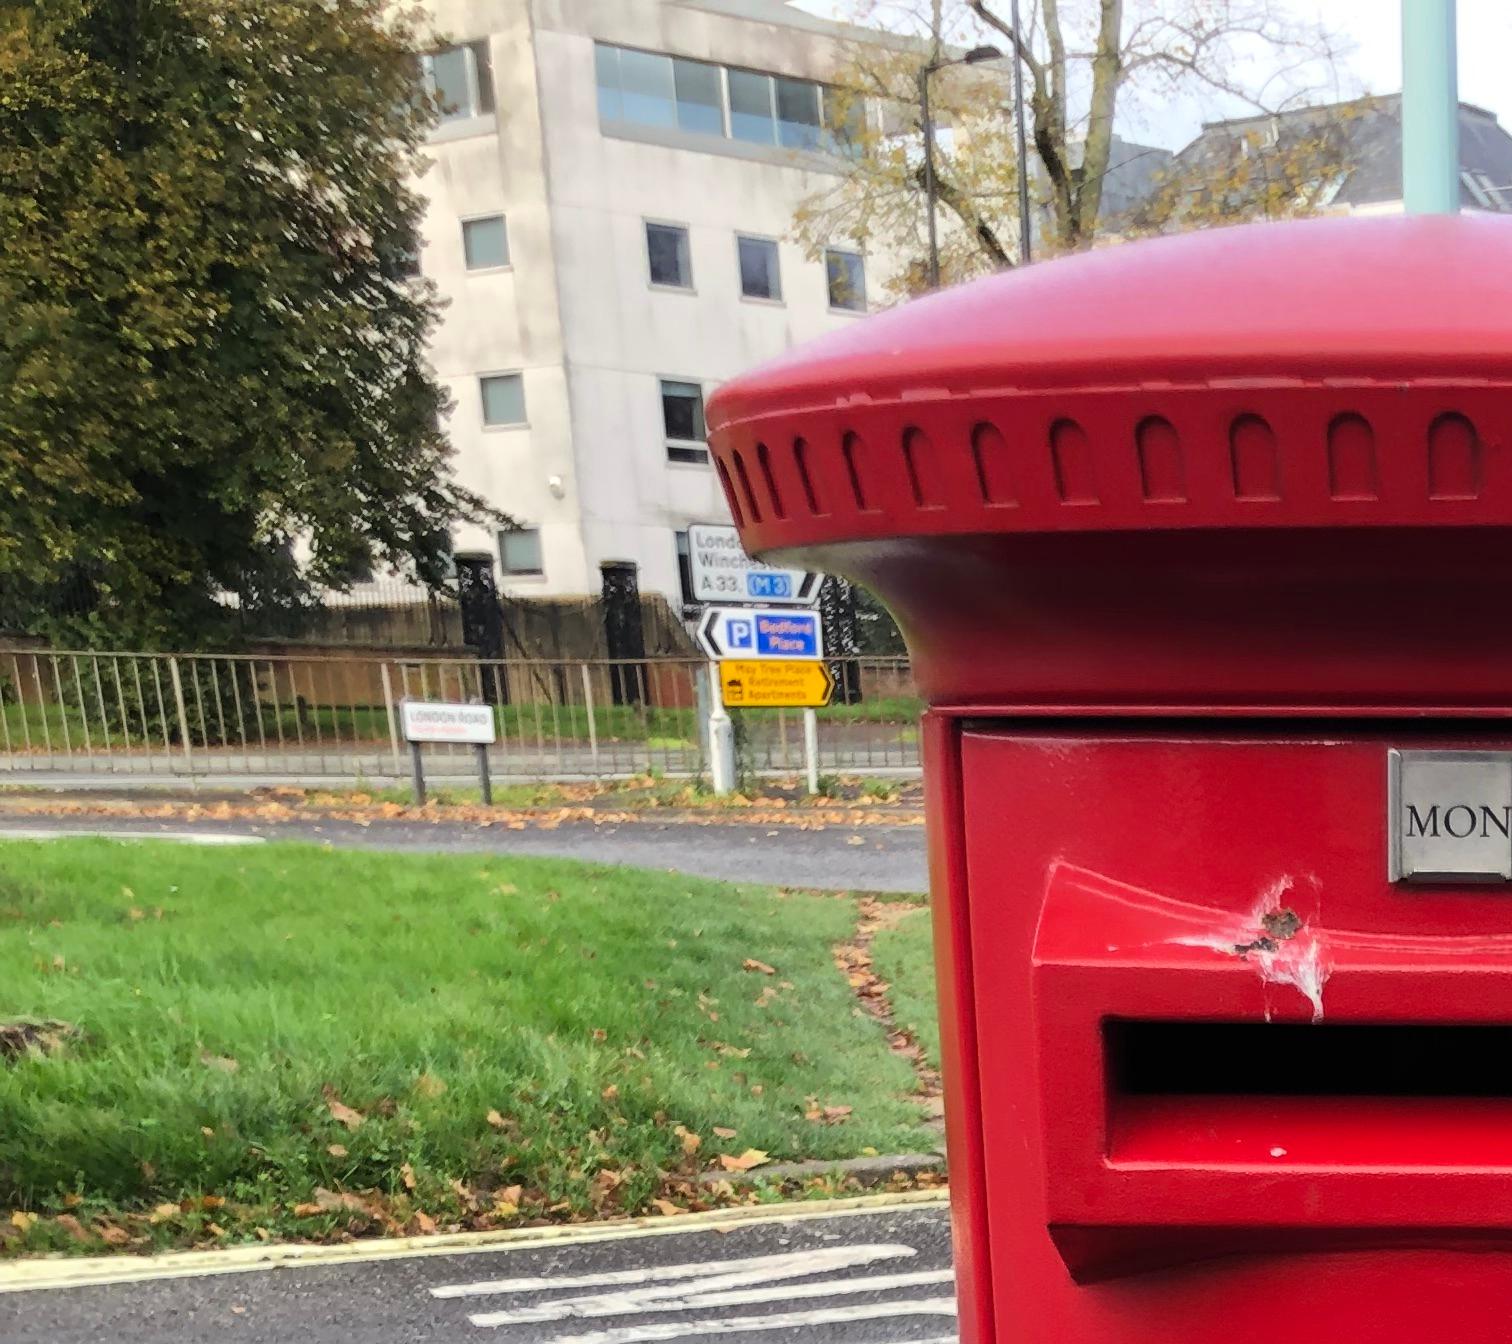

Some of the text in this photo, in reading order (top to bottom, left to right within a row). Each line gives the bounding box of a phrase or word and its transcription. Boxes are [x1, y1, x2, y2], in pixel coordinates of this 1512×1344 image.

[696, 531, 743, 549] Lond
[732, 623, 748, 646] P
[1406, 805, 1512, 838] MON
